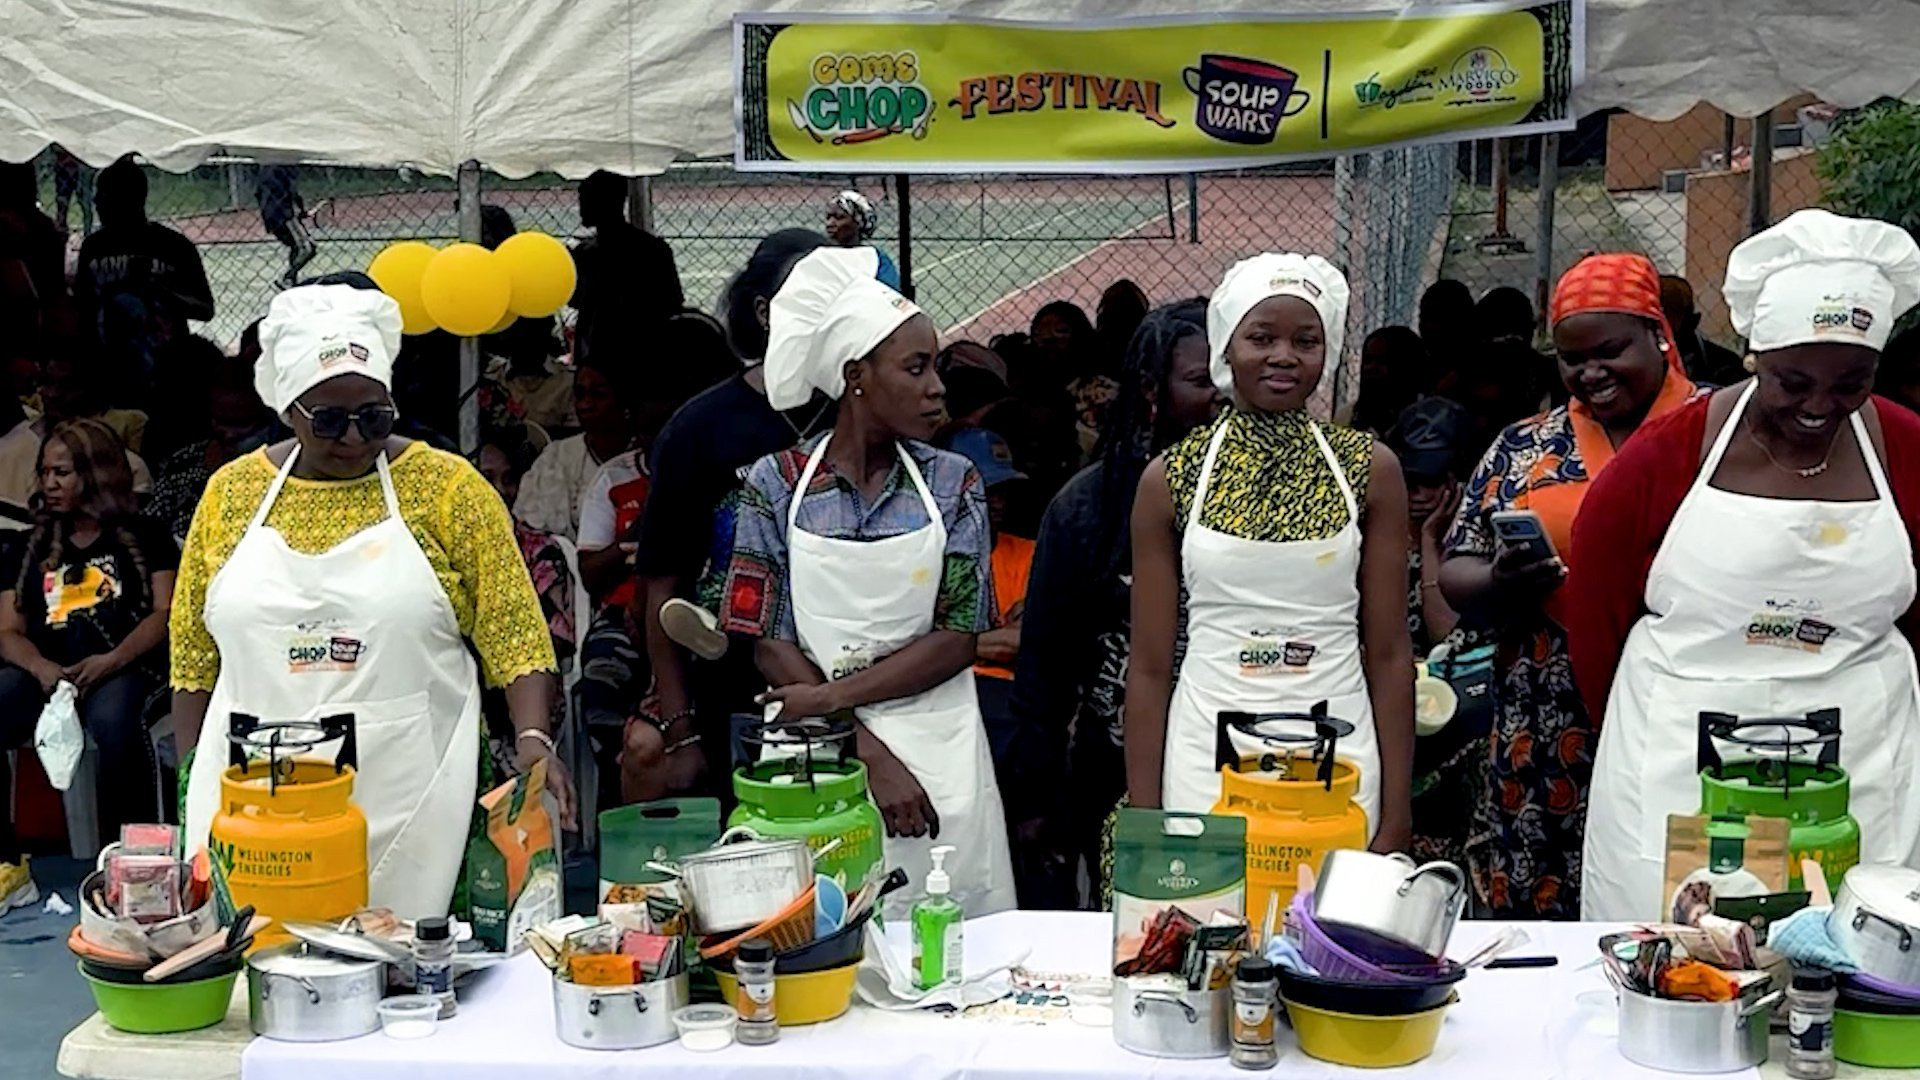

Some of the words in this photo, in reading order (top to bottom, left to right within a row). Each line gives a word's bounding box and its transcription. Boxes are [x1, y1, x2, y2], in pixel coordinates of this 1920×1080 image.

[949, 72, 1177, 128] FESTIVAL
[1205, 79, 1281, 110] SOUP
[808, 86, 928, 130] CHOP
[1205, 103, 1275, 134] WARS
[1748, 622, 1794, 637] CHOP
[289, 646, 327, 661] CHOP
[1239, 650, 1280, 665] CHOP
[238, 846, 313, 863] WELLINGTON
[1246, 841, 1313, 860] ELLINGTON
[238, 861, 292, 877] ENERGIES
[1250, 856, 1291, 873] ERGIES
